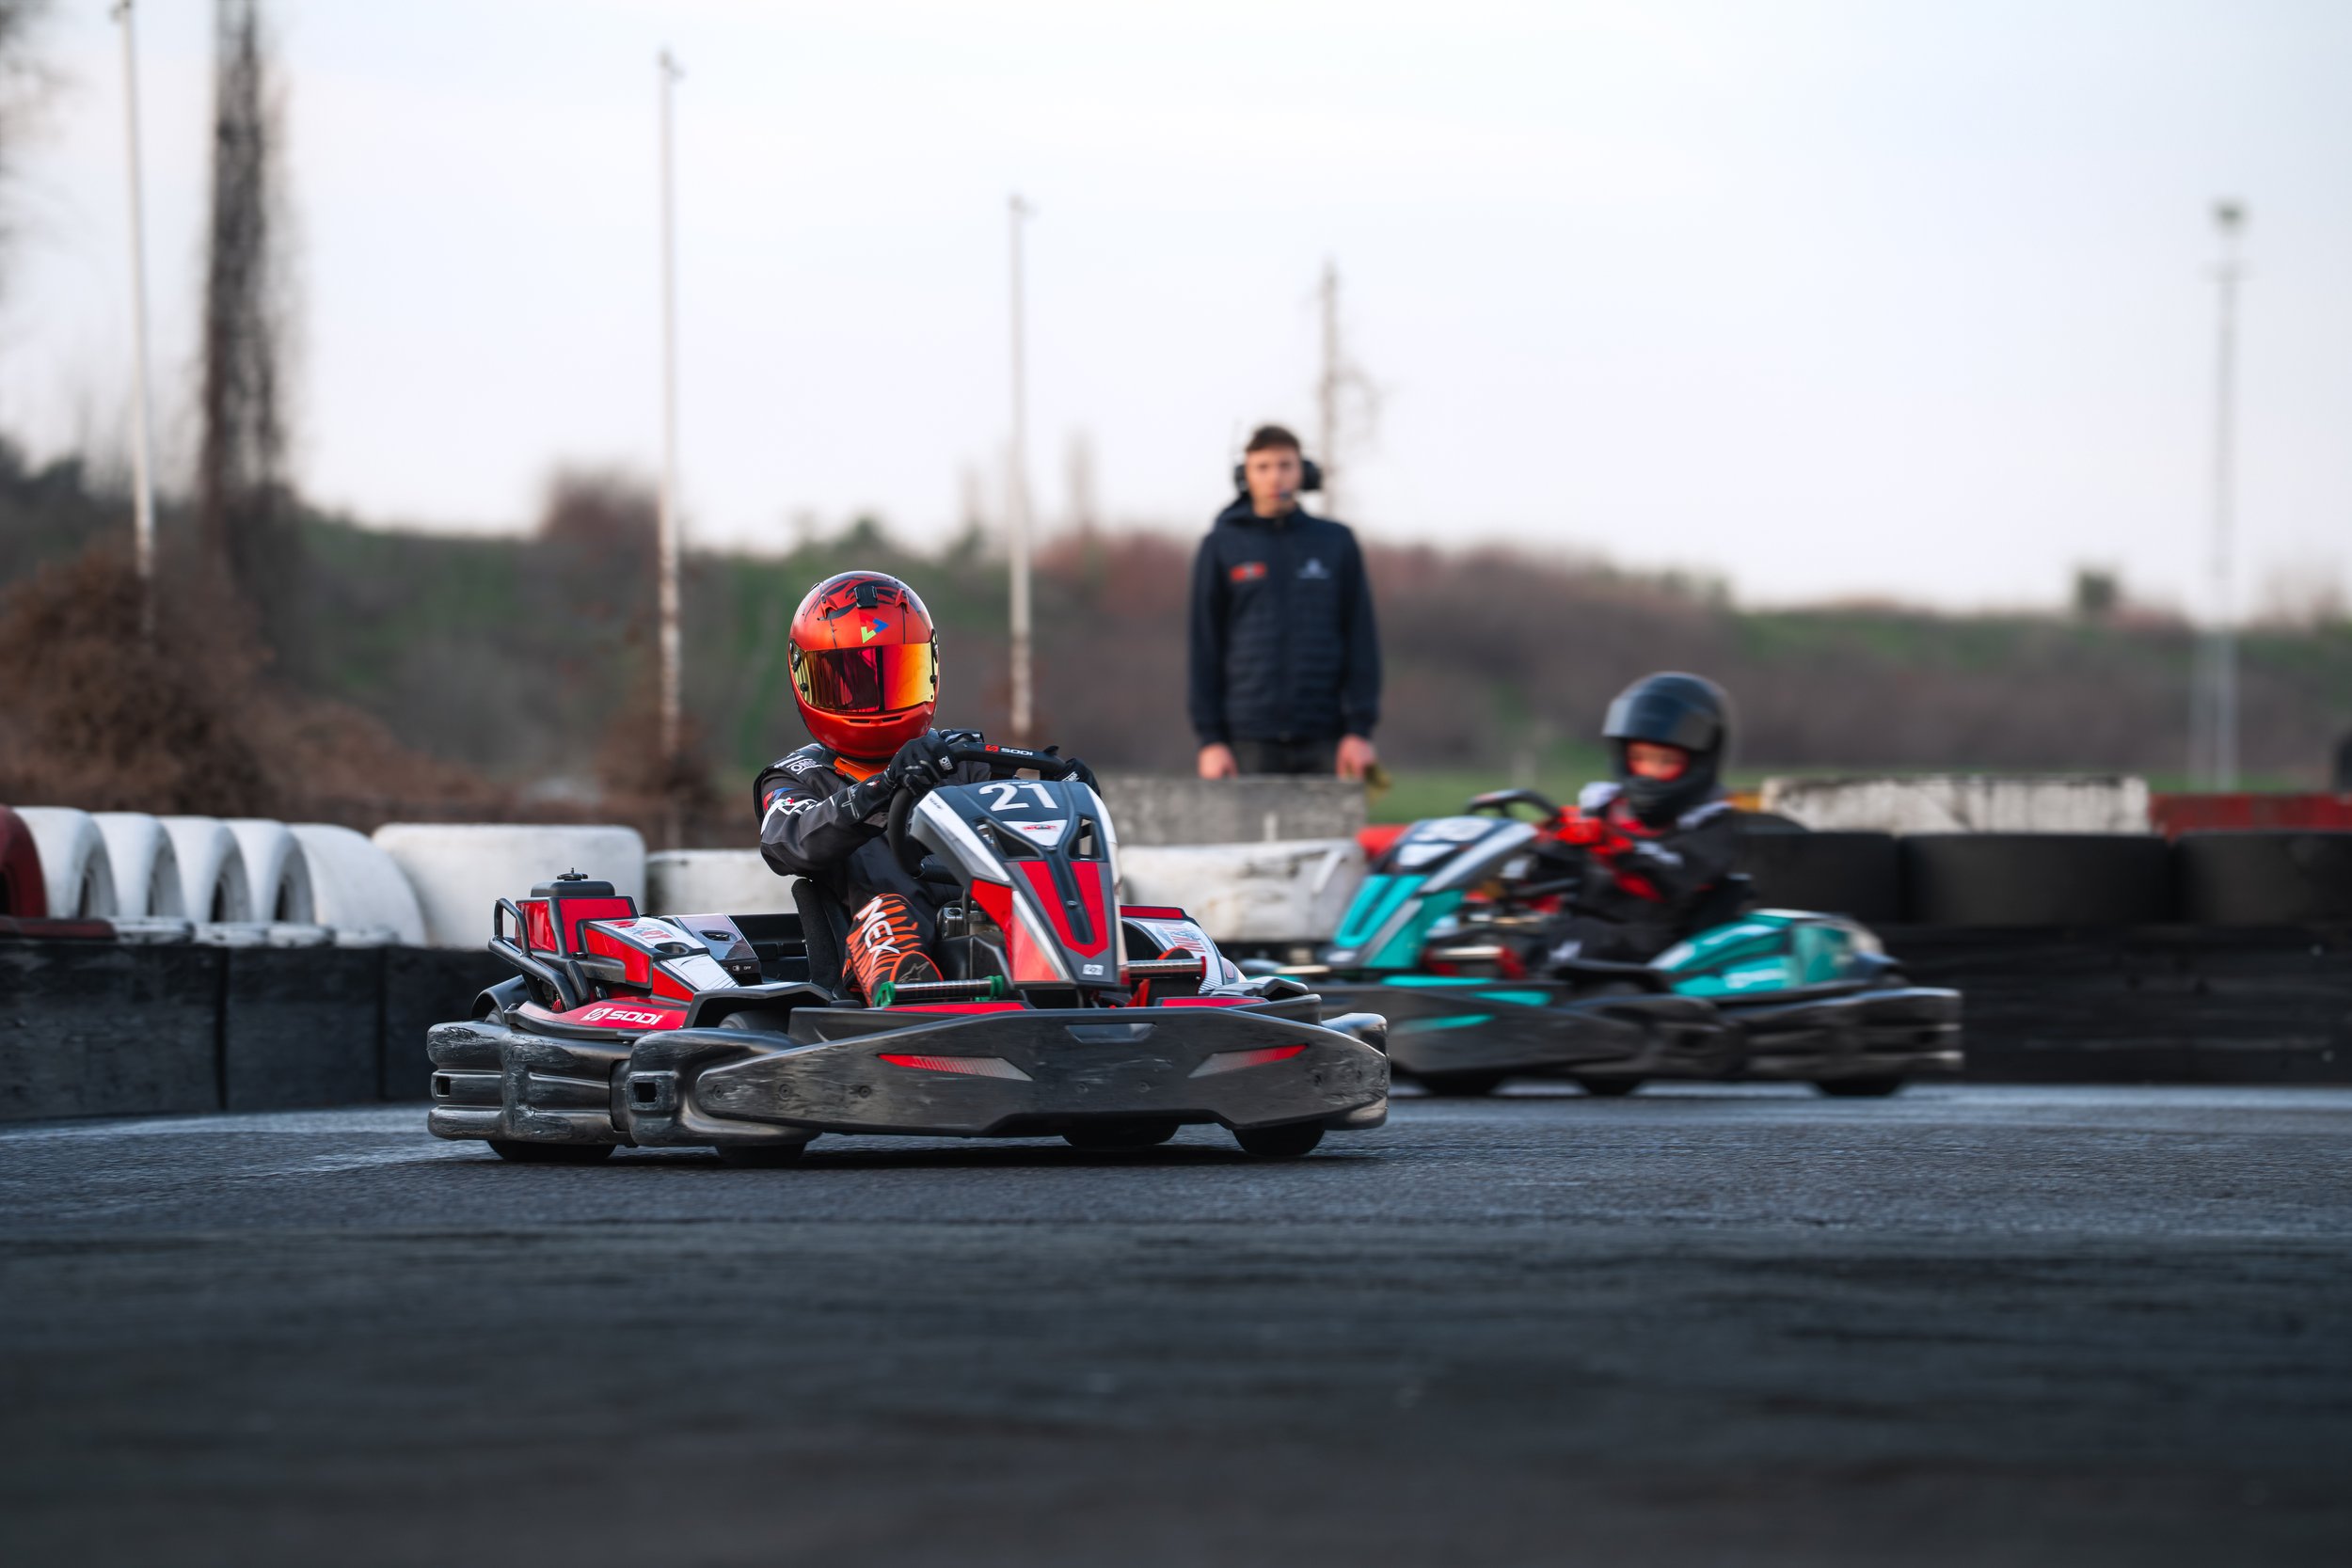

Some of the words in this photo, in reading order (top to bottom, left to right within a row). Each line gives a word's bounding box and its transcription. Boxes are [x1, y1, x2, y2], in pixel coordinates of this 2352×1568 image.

[1000, 747, 1033, 756] SODI
[978, 782, 1058, 812] 21
[605, 1010, 663, 1025] SODI
